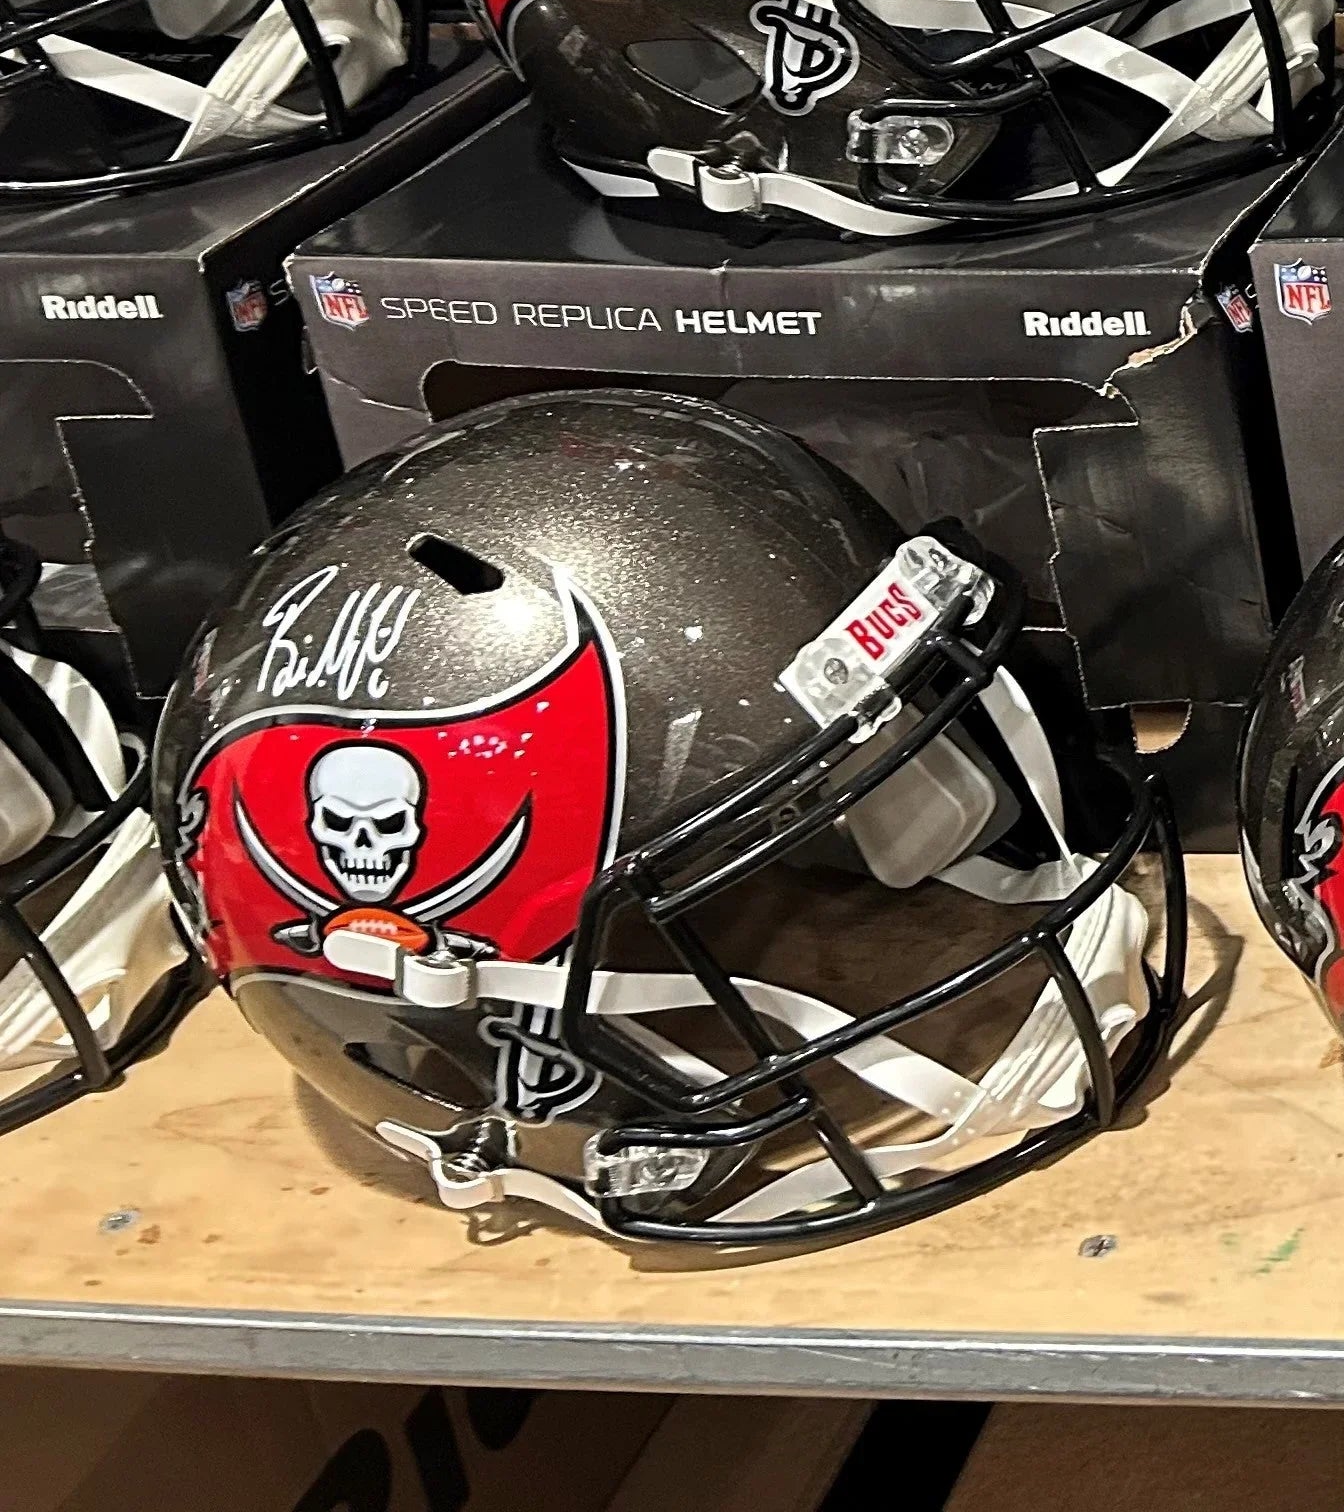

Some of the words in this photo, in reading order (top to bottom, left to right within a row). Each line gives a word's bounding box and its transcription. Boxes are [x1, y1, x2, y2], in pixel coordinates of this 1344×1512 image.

[41, 295, 164, 320] Riddell
[322, 293, 368, 320] NFL
[1286, 284, 1331, 313] NFL
[380, 297, 498, 325] SPEED
[515, 303, 662, 332] REPLICA
[675, 309, 822, 335] HELMET
[1023, 311, 1152, 337] Riddell
[843, 581, 923, 662] BUCS
